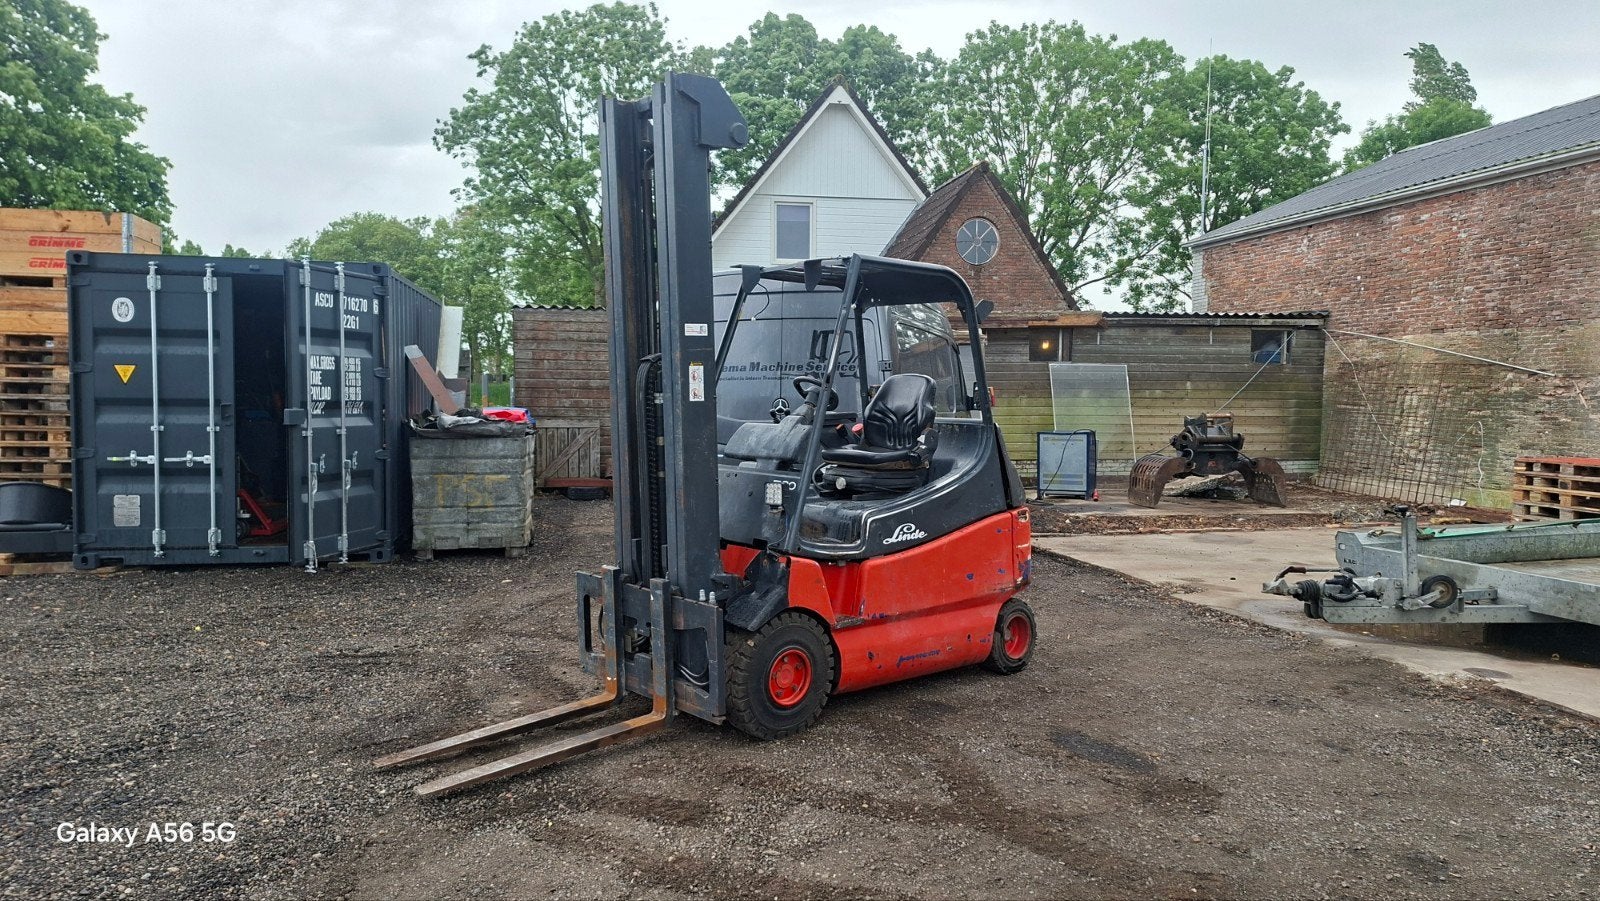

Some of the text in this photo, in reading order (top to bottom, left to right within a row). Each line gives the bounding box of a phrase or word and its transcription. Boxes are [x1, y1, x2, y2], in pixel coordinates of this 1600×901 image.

[28, 236, 86, 248] GRIMME
[28, 257, 66, 269] GRIM
[315, 292, 379, 314] ASCU 716270 6
[720, 361, 856, 373] ema Machine Serice
[883, 523, 928, 545] Linde
